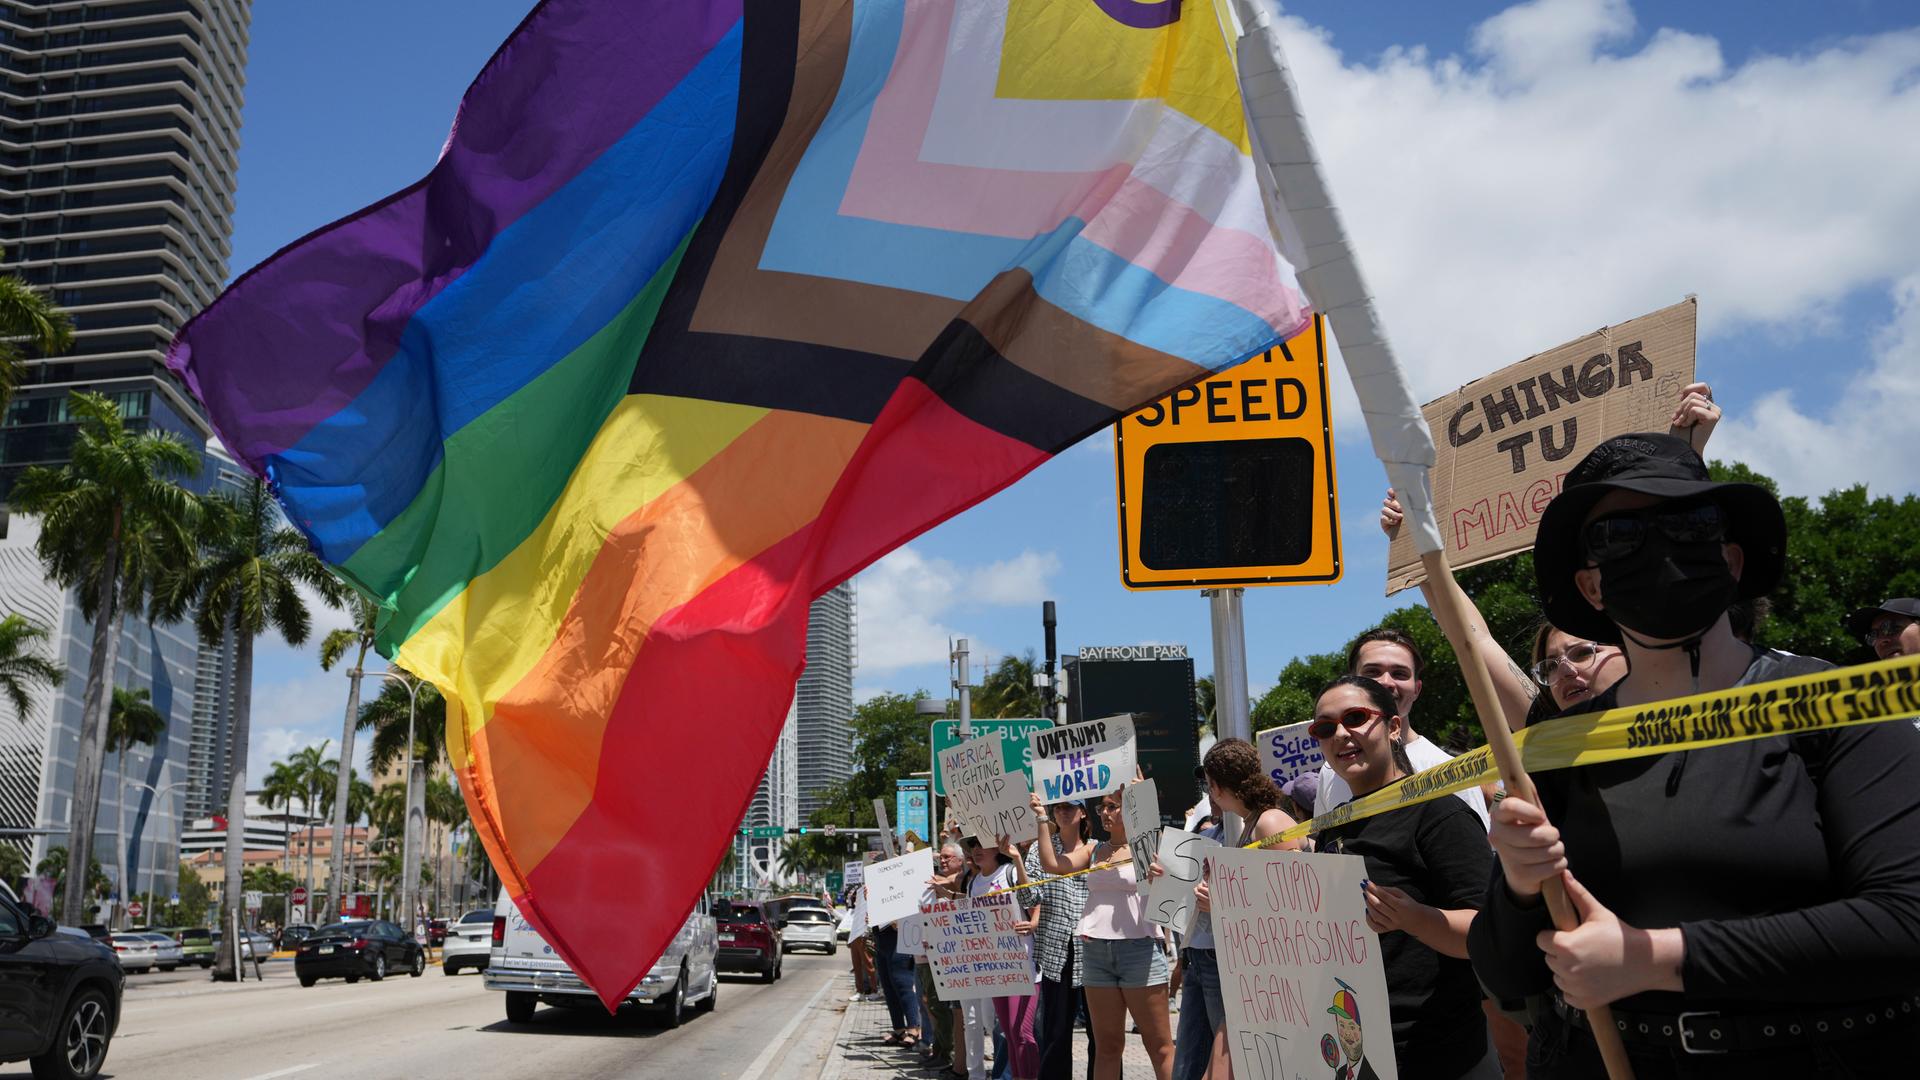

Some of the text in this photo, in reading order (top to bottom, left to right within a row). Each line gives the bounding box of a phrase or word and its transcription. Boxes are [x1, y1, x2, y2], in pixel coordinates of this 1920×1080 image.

[1136, 378, 1307, 427] SPEED
[1448, 341, 1653, 448] CHINGA
[1497, 417, 1578, 474] TU
[1615, 439, 1658, 456] BEACH
[1453, 473, 1568, 551] MAG
[1080, 645, 1187, 660] BAYFRONT PARK
[1846, 664, 1920, 722] OLICE
[1627, 703, 1692, 749] CROSS
[1692, 696, 1740, 741] NOT
[1739, 691, 1779, 735] DO
[947, 726, 989, 740] PRT
[1036, 721, 1106, 759] UNTRUMP
[1271, 734, 1320, 758] Scien
[946, 742, 994, 774] AMERICA
[1056, 748, 1095, 772] THE
[1281, 753, 1325, 768] Tru
[950, 760, 999, 790] FIGHTING
[1043, 764, 1111, 801] WORLD
[957, 778, 1006, 812] DUMP
[969, 805, 1026, 838] TRUMP
[292, 893, 306, 901] STOP
[1209, 856, 1252, 911] MAKE
[1265, 860, 1321, 914] STUPID
[921, 901, 957, 914] WAKE
[971, 893, 1012, 908] AMERICA
[930, 908, 1012, 927] WE NEED TO
[943, 919, 1018, 936] UNITE NOW
[937, 940, 957, 953] GOP
[966, 936, 995, 951] DEMS
[956, 951, 1000, 964] ECONOMIC
[1002, 951, 1029, 961] CHAOS
[1221, 916, 1368, 974] EMBARRASSING
[943, 960, 1024, 975] SAVE DEMOCRACY
[946, 977, 973, 989] SAVE
[974, 975, 996, 986] FREE
[1239, 973, 1310, 1028] AGAIN
